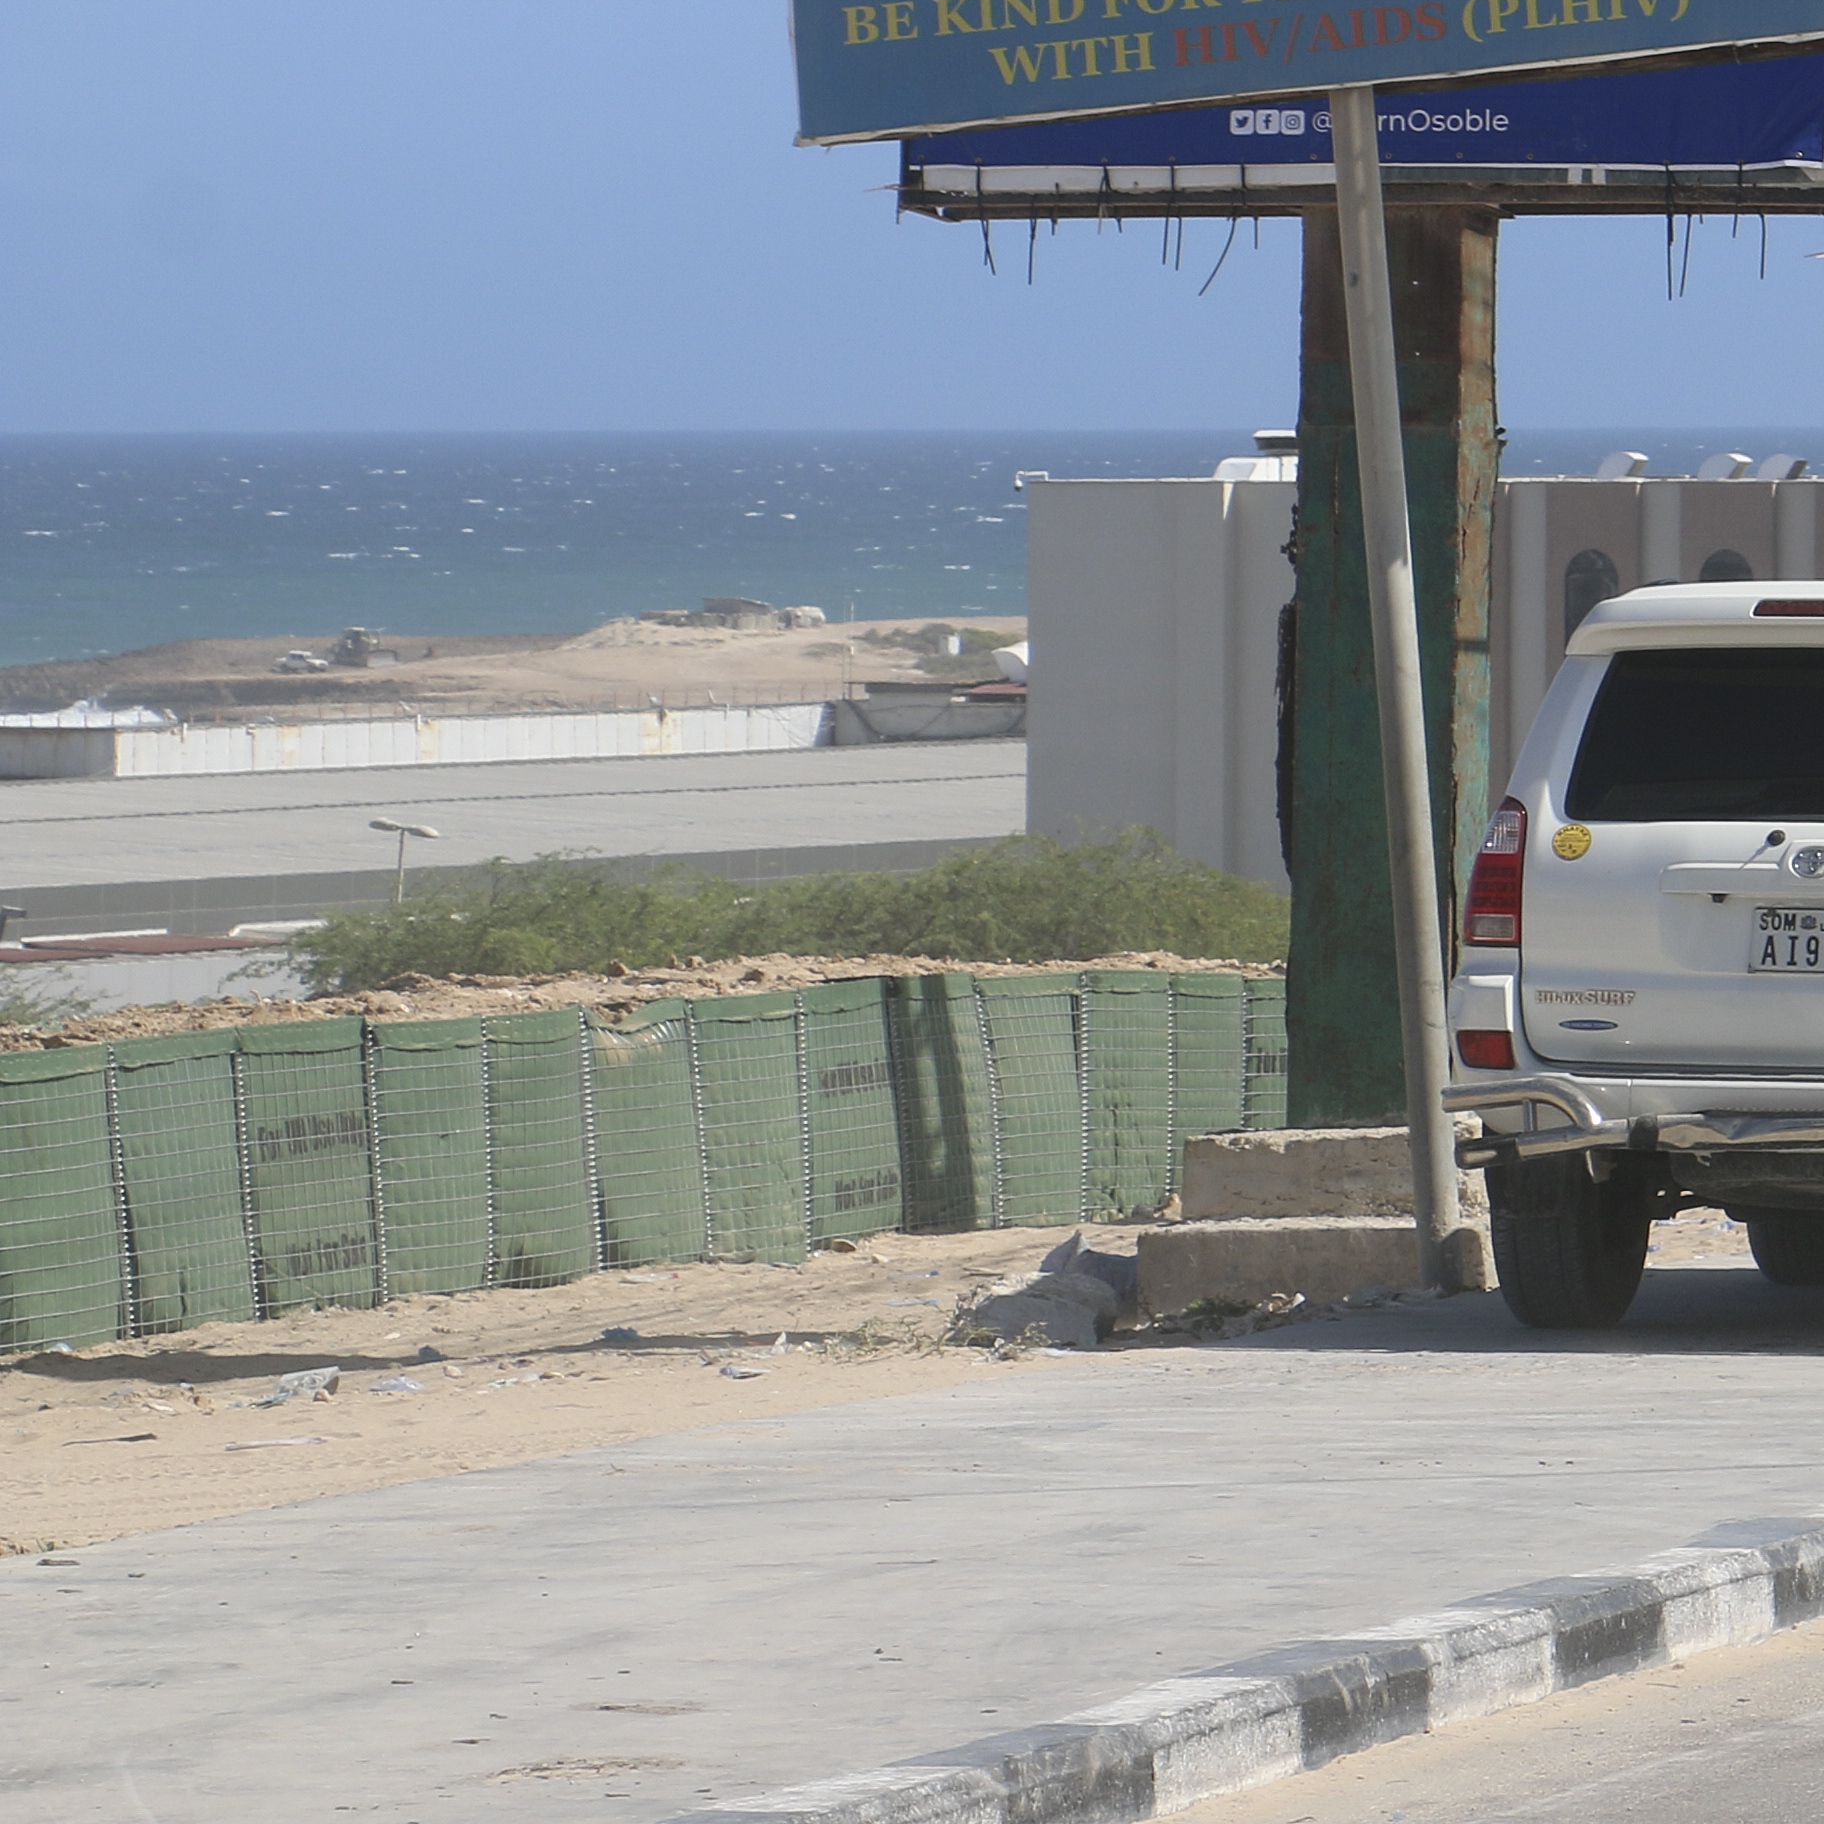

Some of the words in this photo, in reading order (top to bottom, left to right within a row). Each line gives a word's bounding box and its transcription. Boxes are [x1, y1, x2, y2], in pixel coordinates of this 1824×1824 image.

[842, 1, 918, 46] BE
[988, 31, 1156, 87] WITH
[1172, 1, 1448, 67] HIV/AIDS
[1760, 913, 1797, 931] SOM
